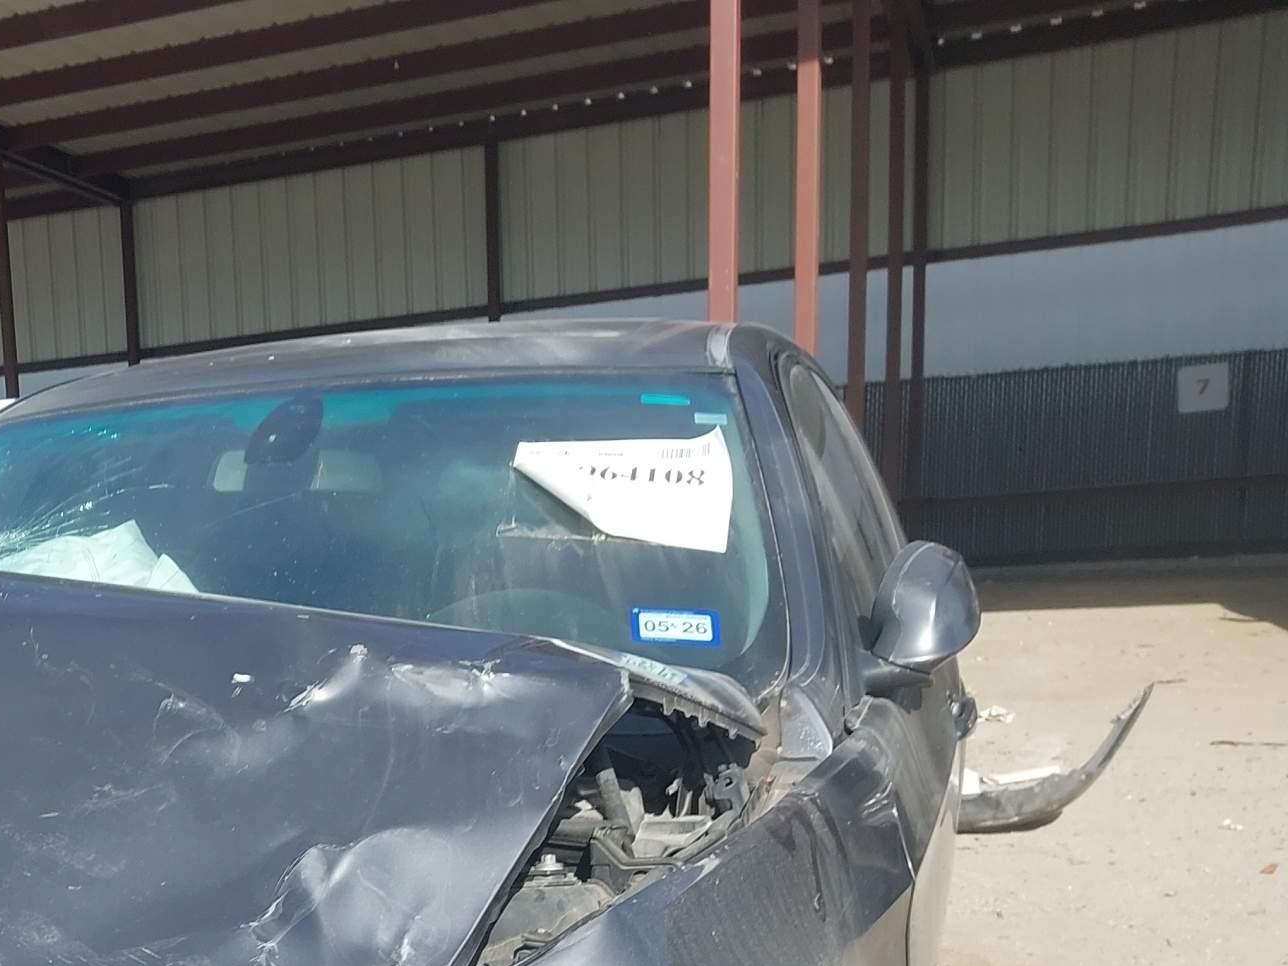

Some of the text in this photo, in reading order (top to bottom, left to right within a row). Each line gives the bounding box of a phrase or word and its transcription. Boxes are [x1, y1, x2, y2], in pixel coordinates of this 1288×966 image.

[1196, 377, 1210, 394] 7
[644, 620, 708, 634] 05 26
